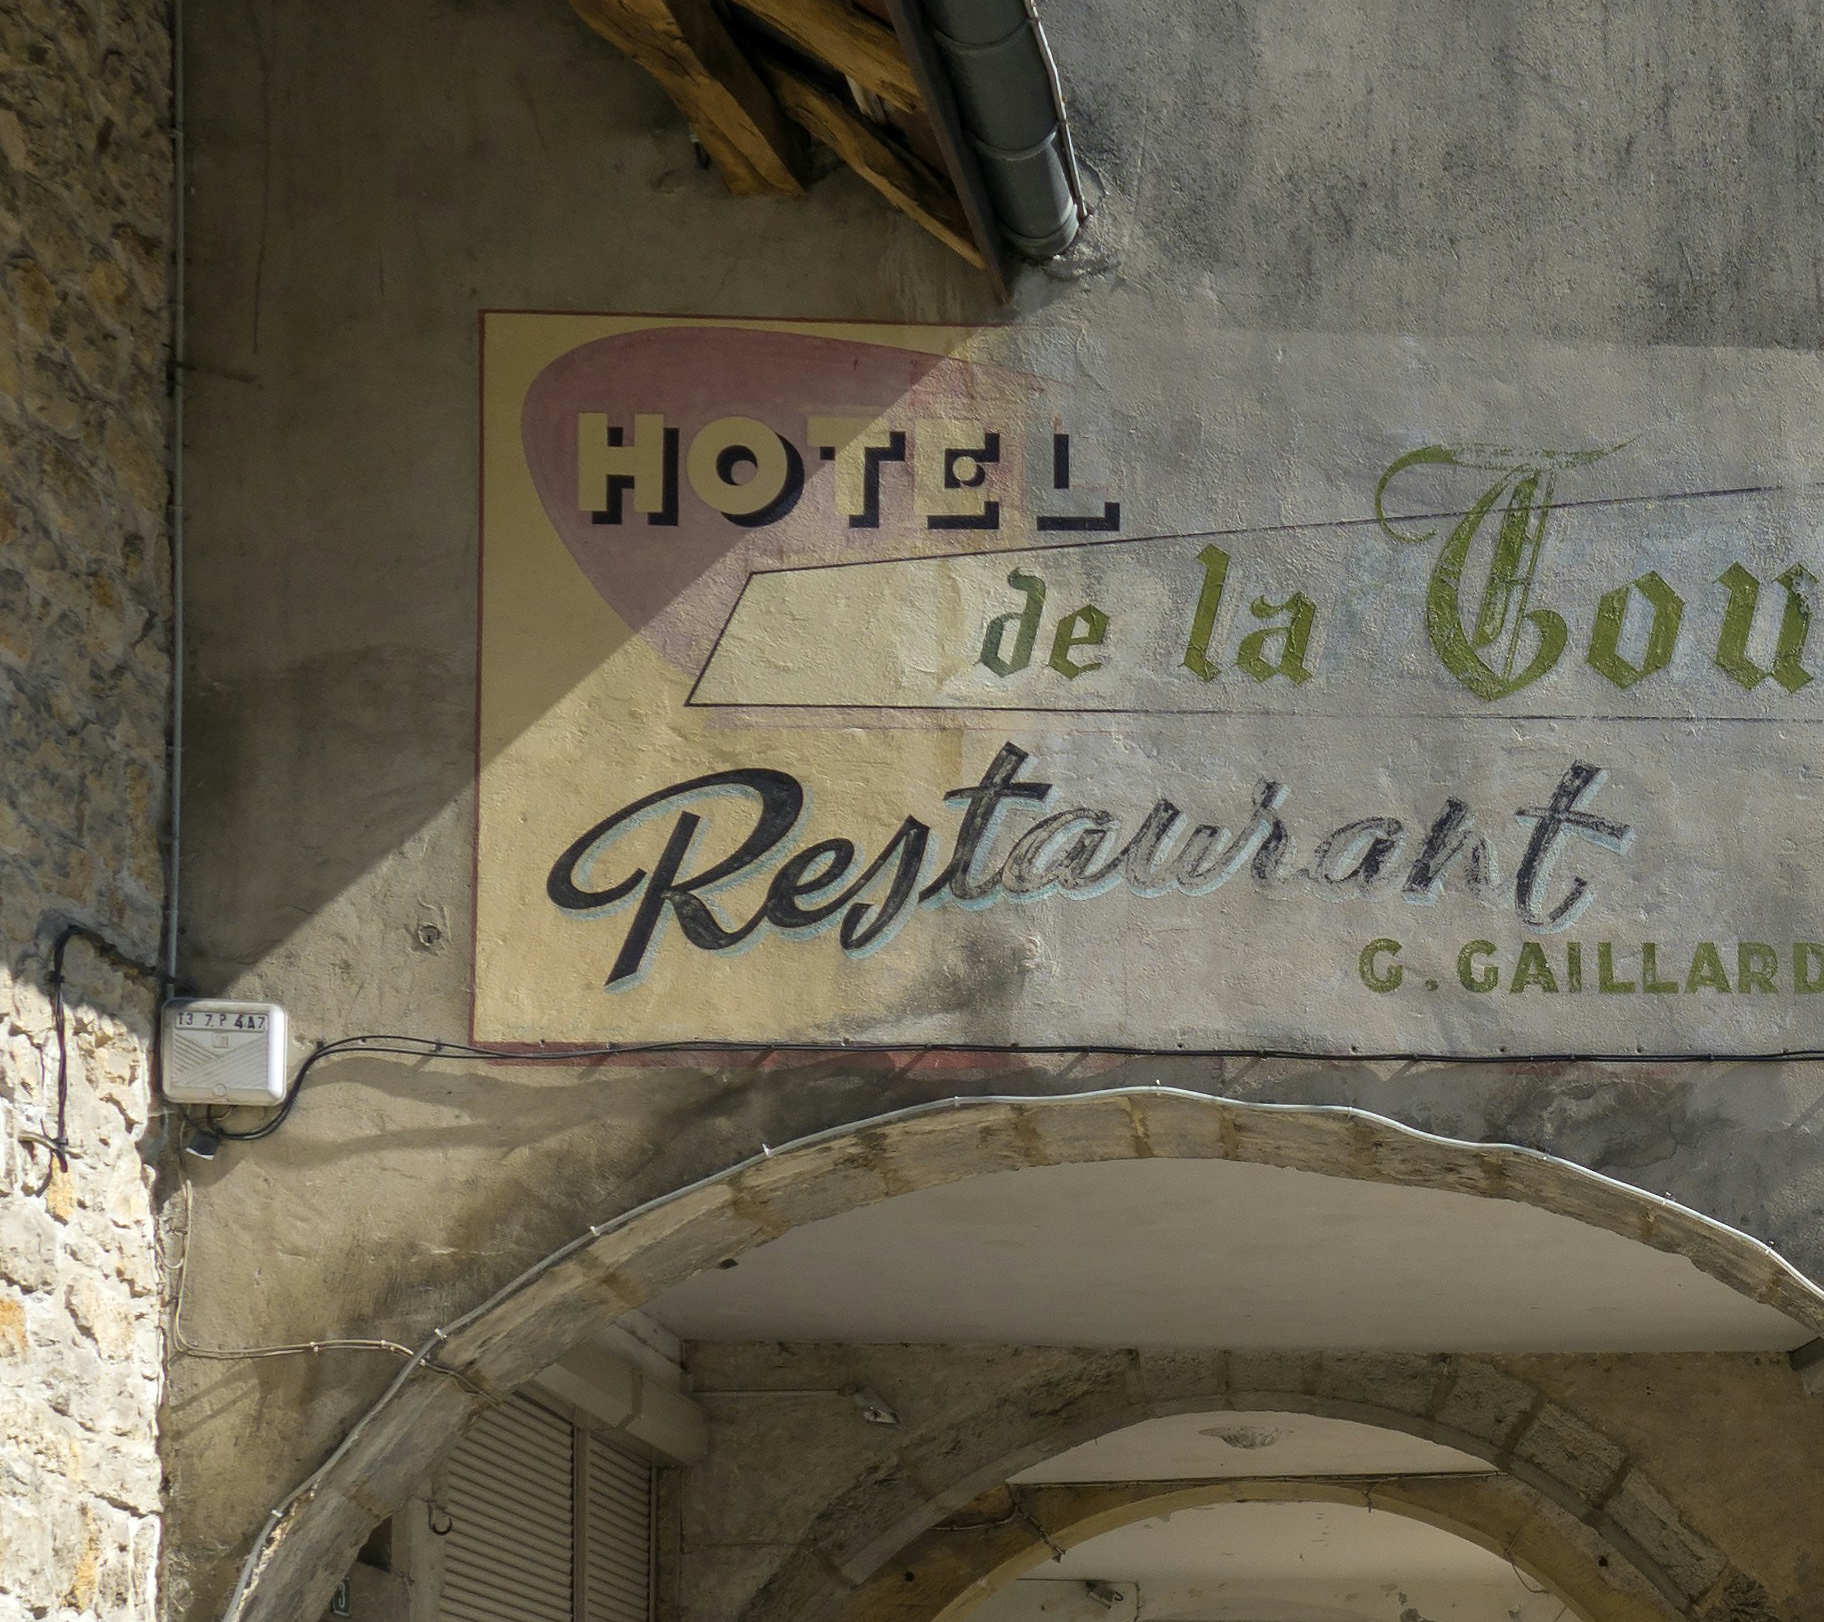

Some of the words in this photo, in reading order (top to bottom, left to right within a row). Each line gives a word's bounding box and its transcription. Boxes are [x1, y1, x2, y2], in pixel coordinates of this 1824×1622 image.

[577, 412, 1120, 531] HOTEL
[974, 567, 1110, 679] de
[1178, 543, 1316, 683] la
[546, 741, 1630, 987] Restaurant
